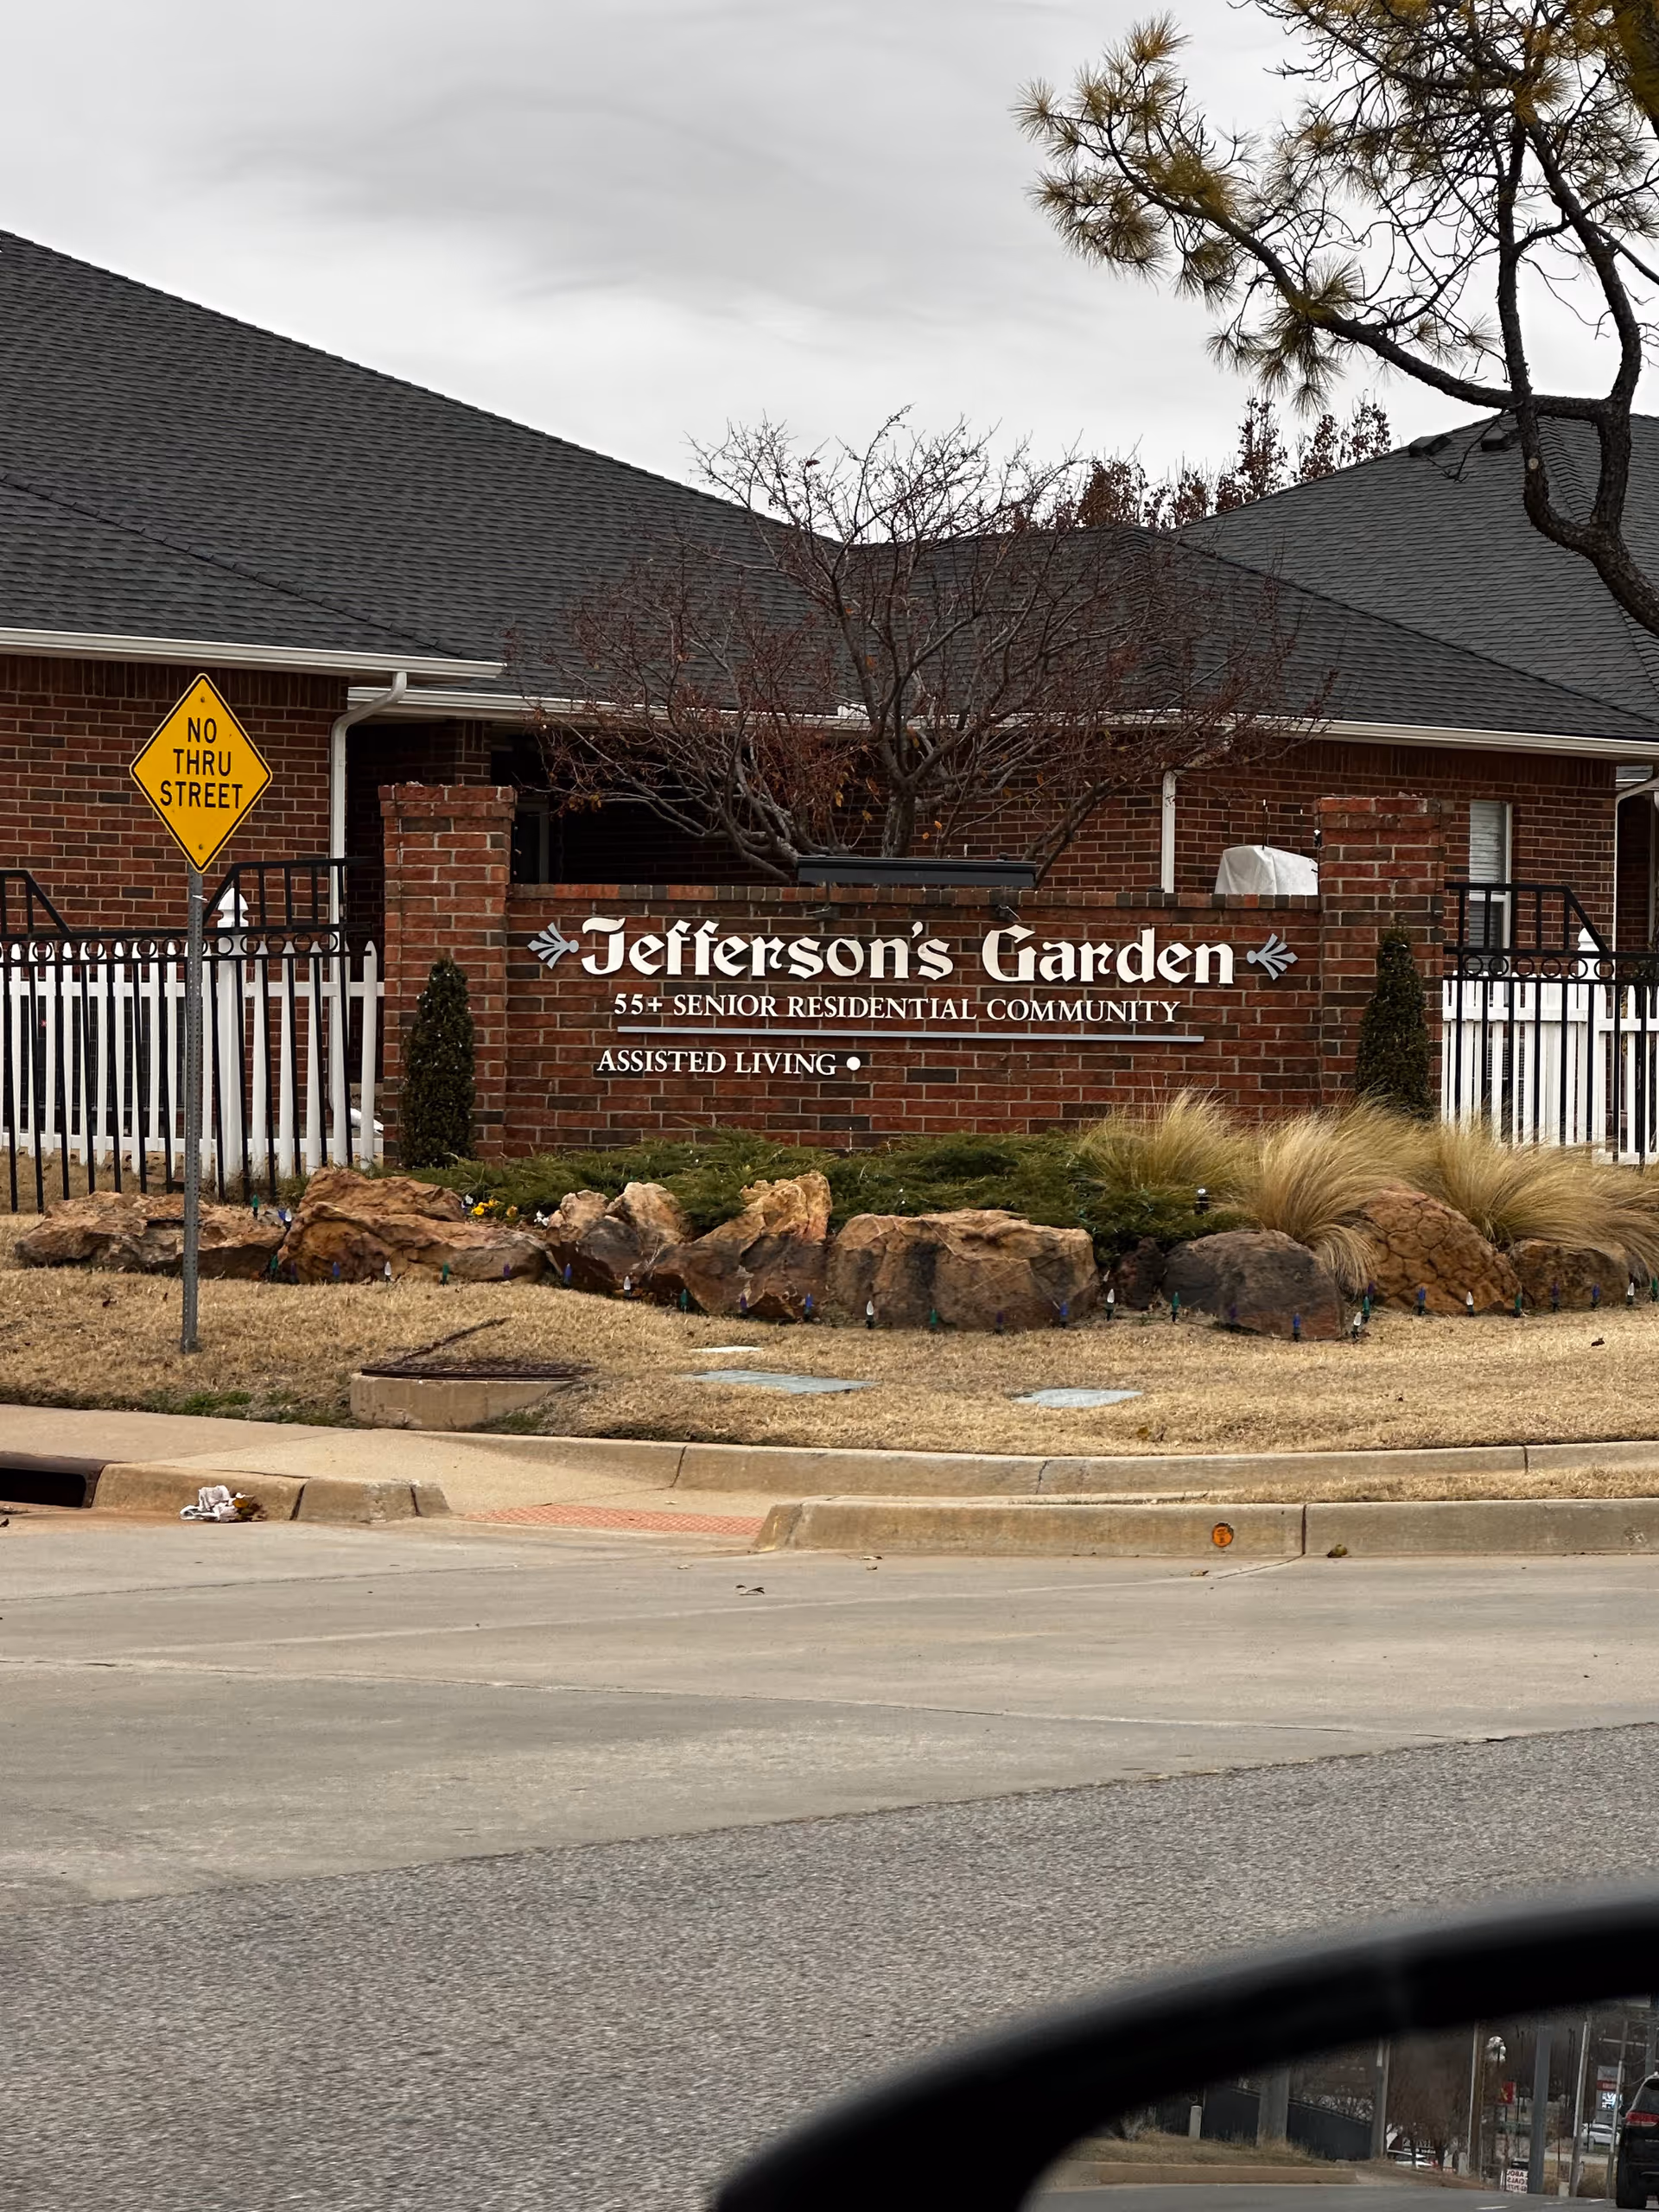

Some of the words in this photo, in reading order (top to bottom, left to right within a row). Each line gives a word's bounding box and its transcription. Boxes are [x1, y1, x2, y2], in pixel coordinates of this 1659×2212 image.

[188, 717, 217, 744] NO
[173, 748, 232, 777] THRU
[160, 780, 244, 810] STREET
[581, 917, 954, 981] Jefferson's
[982, 924, 1234, 984] Garden
[613, 993, 664, 1015] 55+
[673, 994, 778, 1018] SENIOR
[787, 995, 977, 1020] RESIDENTIAL
[986, 998, 1181, 1023] COMMUNITY
[596, 1049, 727, 1073] ASSISTED
[734, 1052, 836, 1076] LIVING
